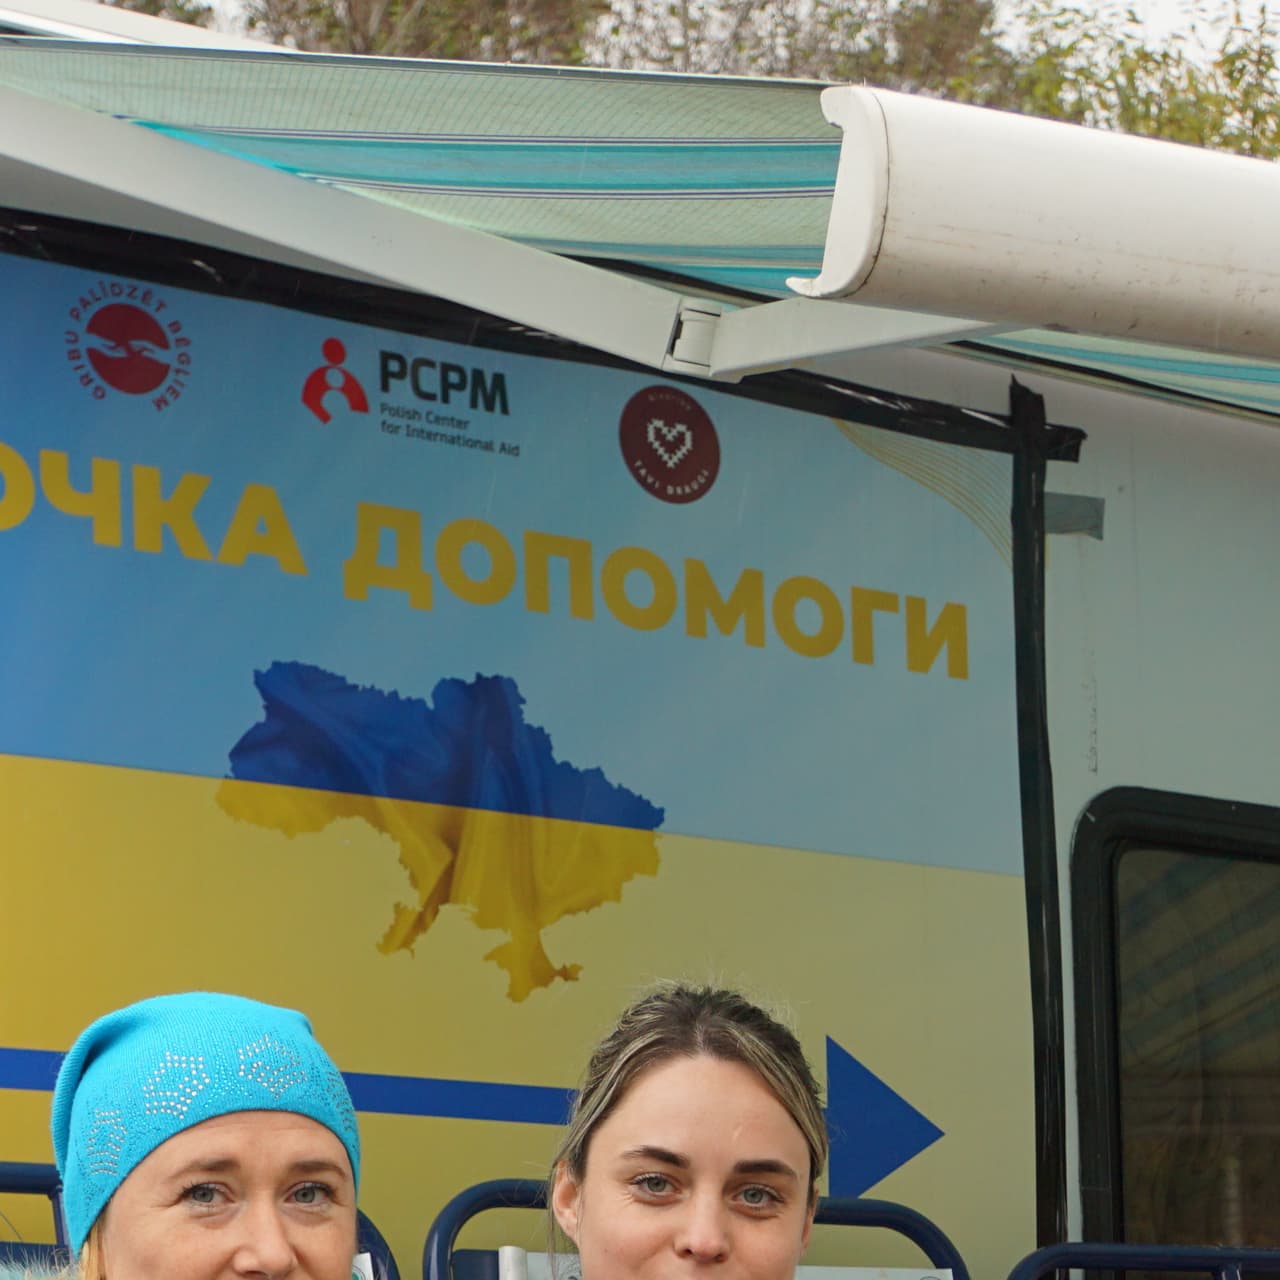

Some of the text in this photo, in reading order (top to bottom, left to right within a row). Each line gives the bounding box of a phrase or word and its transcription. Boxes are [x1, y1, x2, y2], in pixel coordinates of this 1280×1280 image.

[380, 350, 510, 416] PCPM
[380, 403, 469, 430] Polish Center
[381, 420, 520, 457] for International Aid
[343, 502, 970, 680] ДОПОМОГИ
